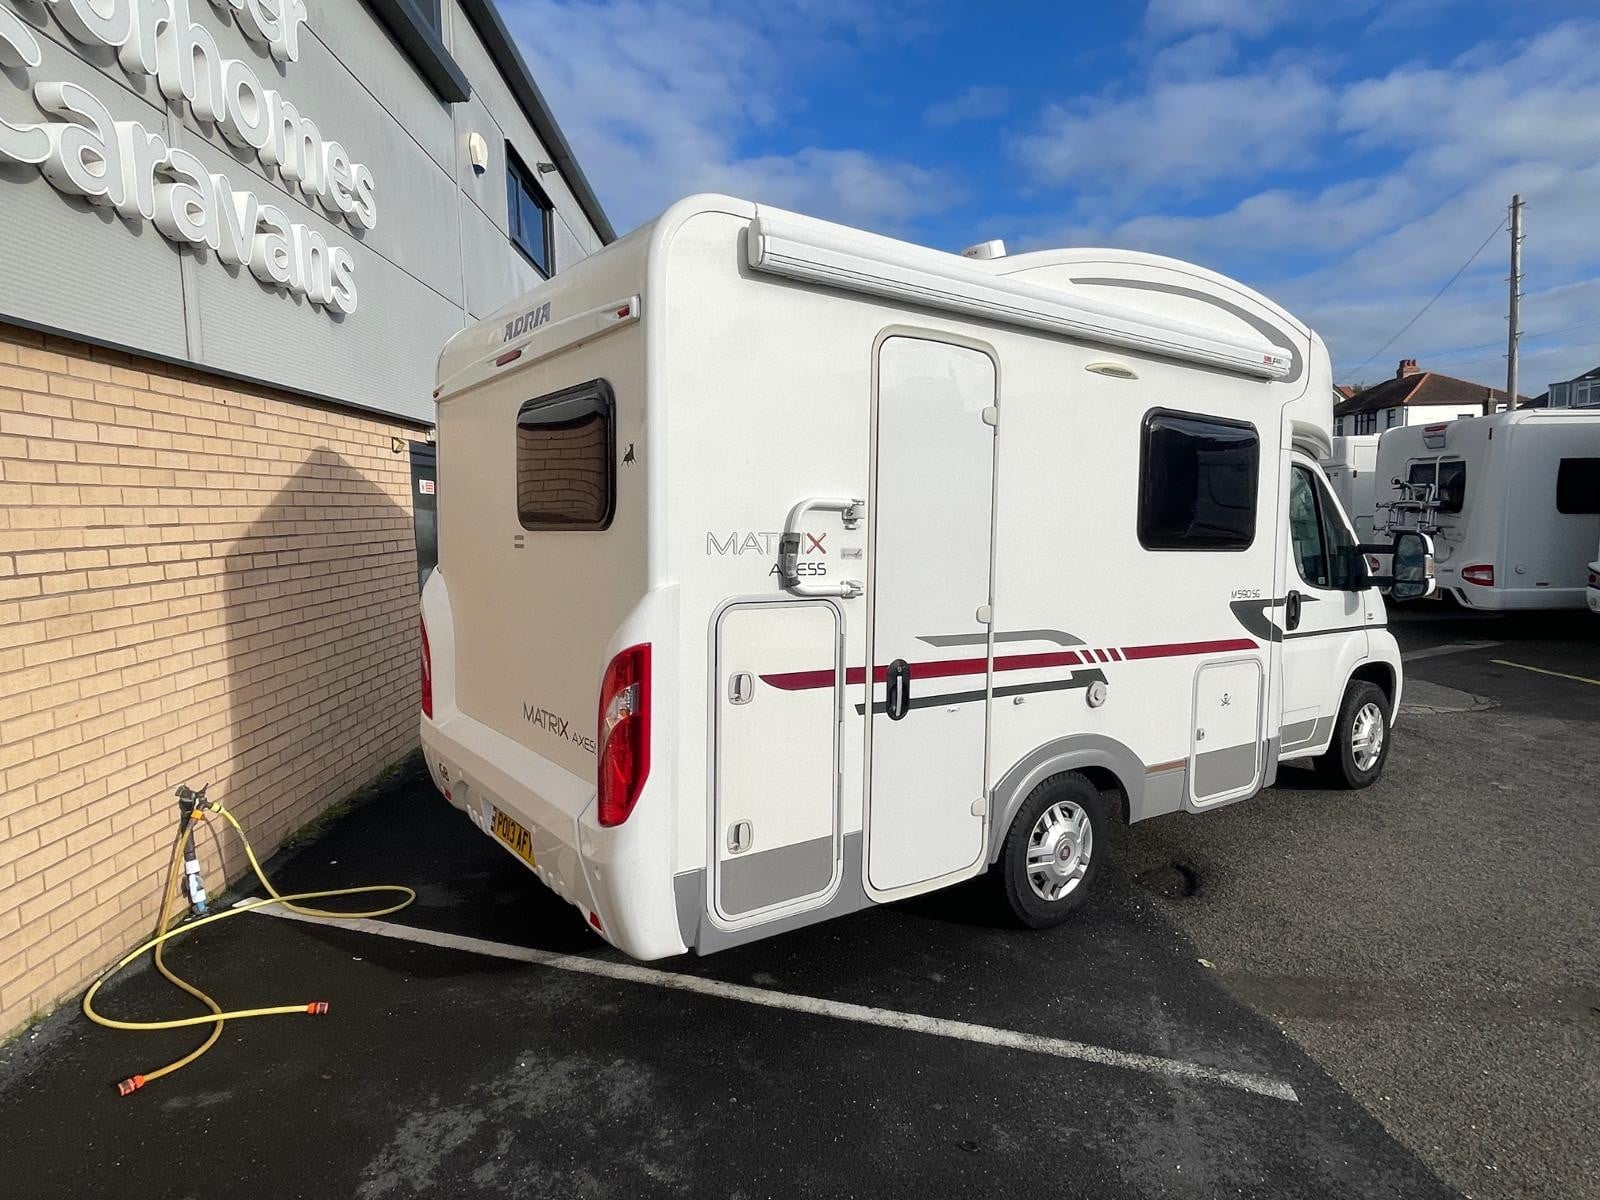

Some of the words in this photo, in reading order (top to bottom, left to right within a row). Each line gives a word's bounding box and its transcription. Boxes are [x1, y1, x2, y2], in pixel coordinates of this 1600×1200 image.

[503, 301, 551, 343] ADRIA
[706, 531, 827, 555] MATIX
[769, 562, 827, 577] AESS
[523, 701, 569, 741] MATRIX
[571, 732, 597, 756] AXES
